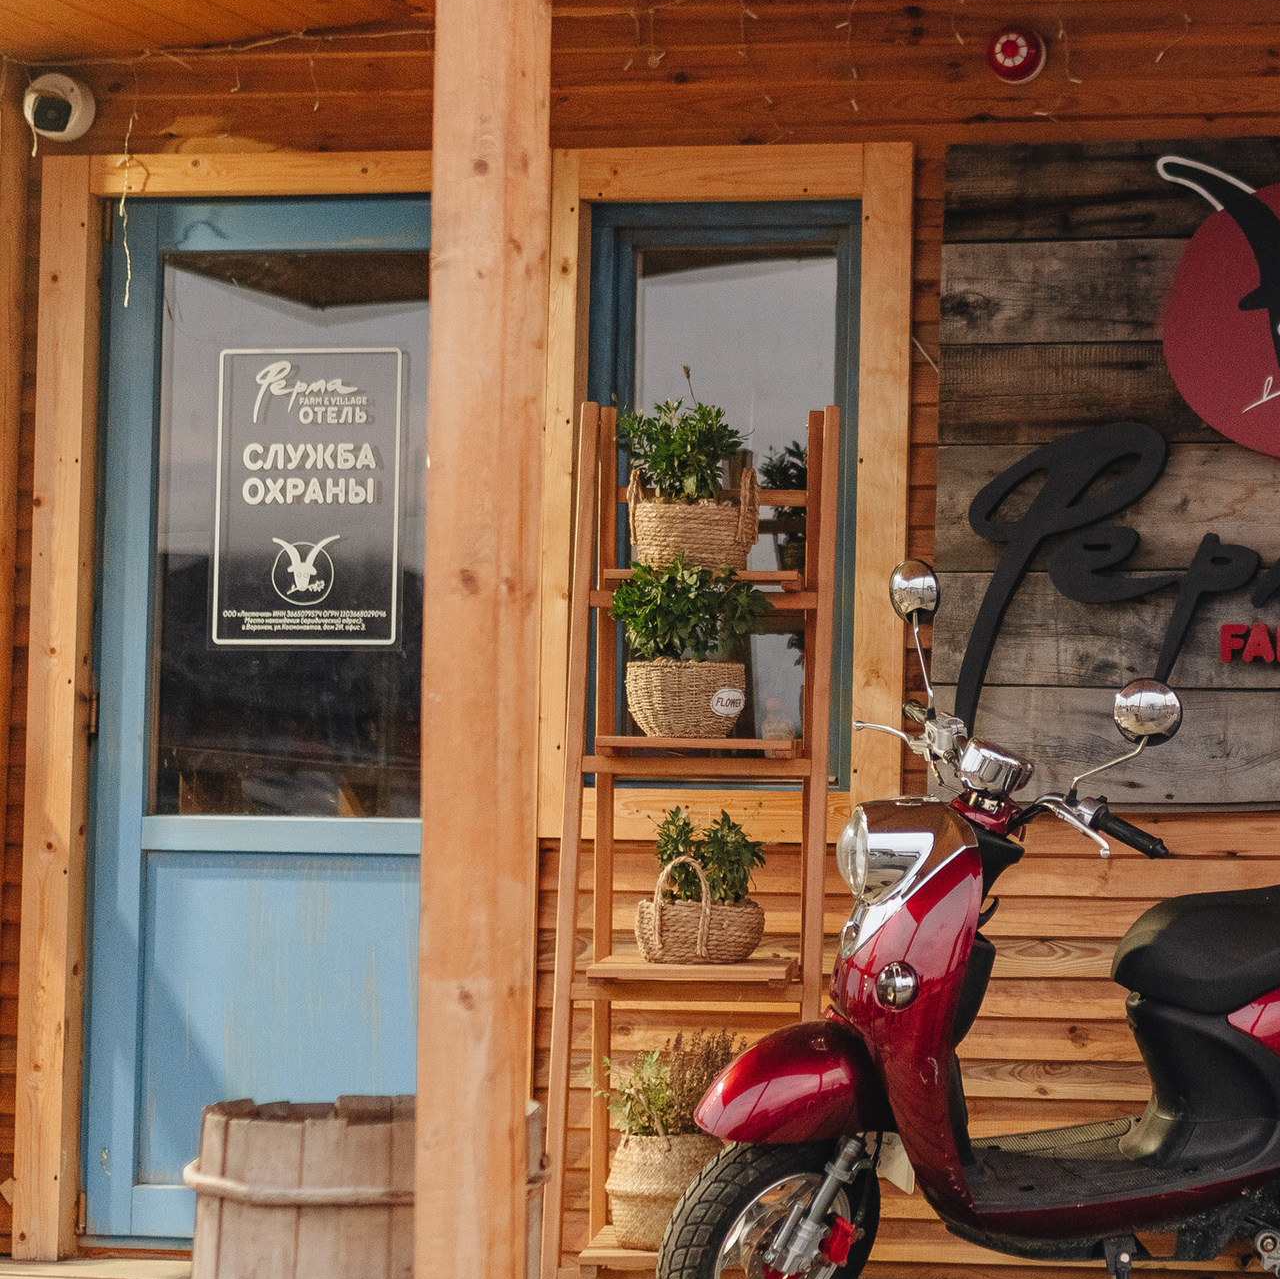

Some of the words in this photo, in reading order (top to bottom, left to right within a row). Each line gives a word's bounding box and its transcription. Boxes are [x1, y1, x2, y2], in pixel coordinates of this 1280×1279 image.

[254, 360, 358, 423] Ферма
[299, 396, 323, 405] FARM
[324, 396, 330, 405] &
[331, 396, 367, 405] VILLAGE
[299, 407, 367, 424] ОТЕЛЬ
[242, 443, 377, 471] СЛУЖБА
[242, 477, 375, 505] ОХРАНЫ
